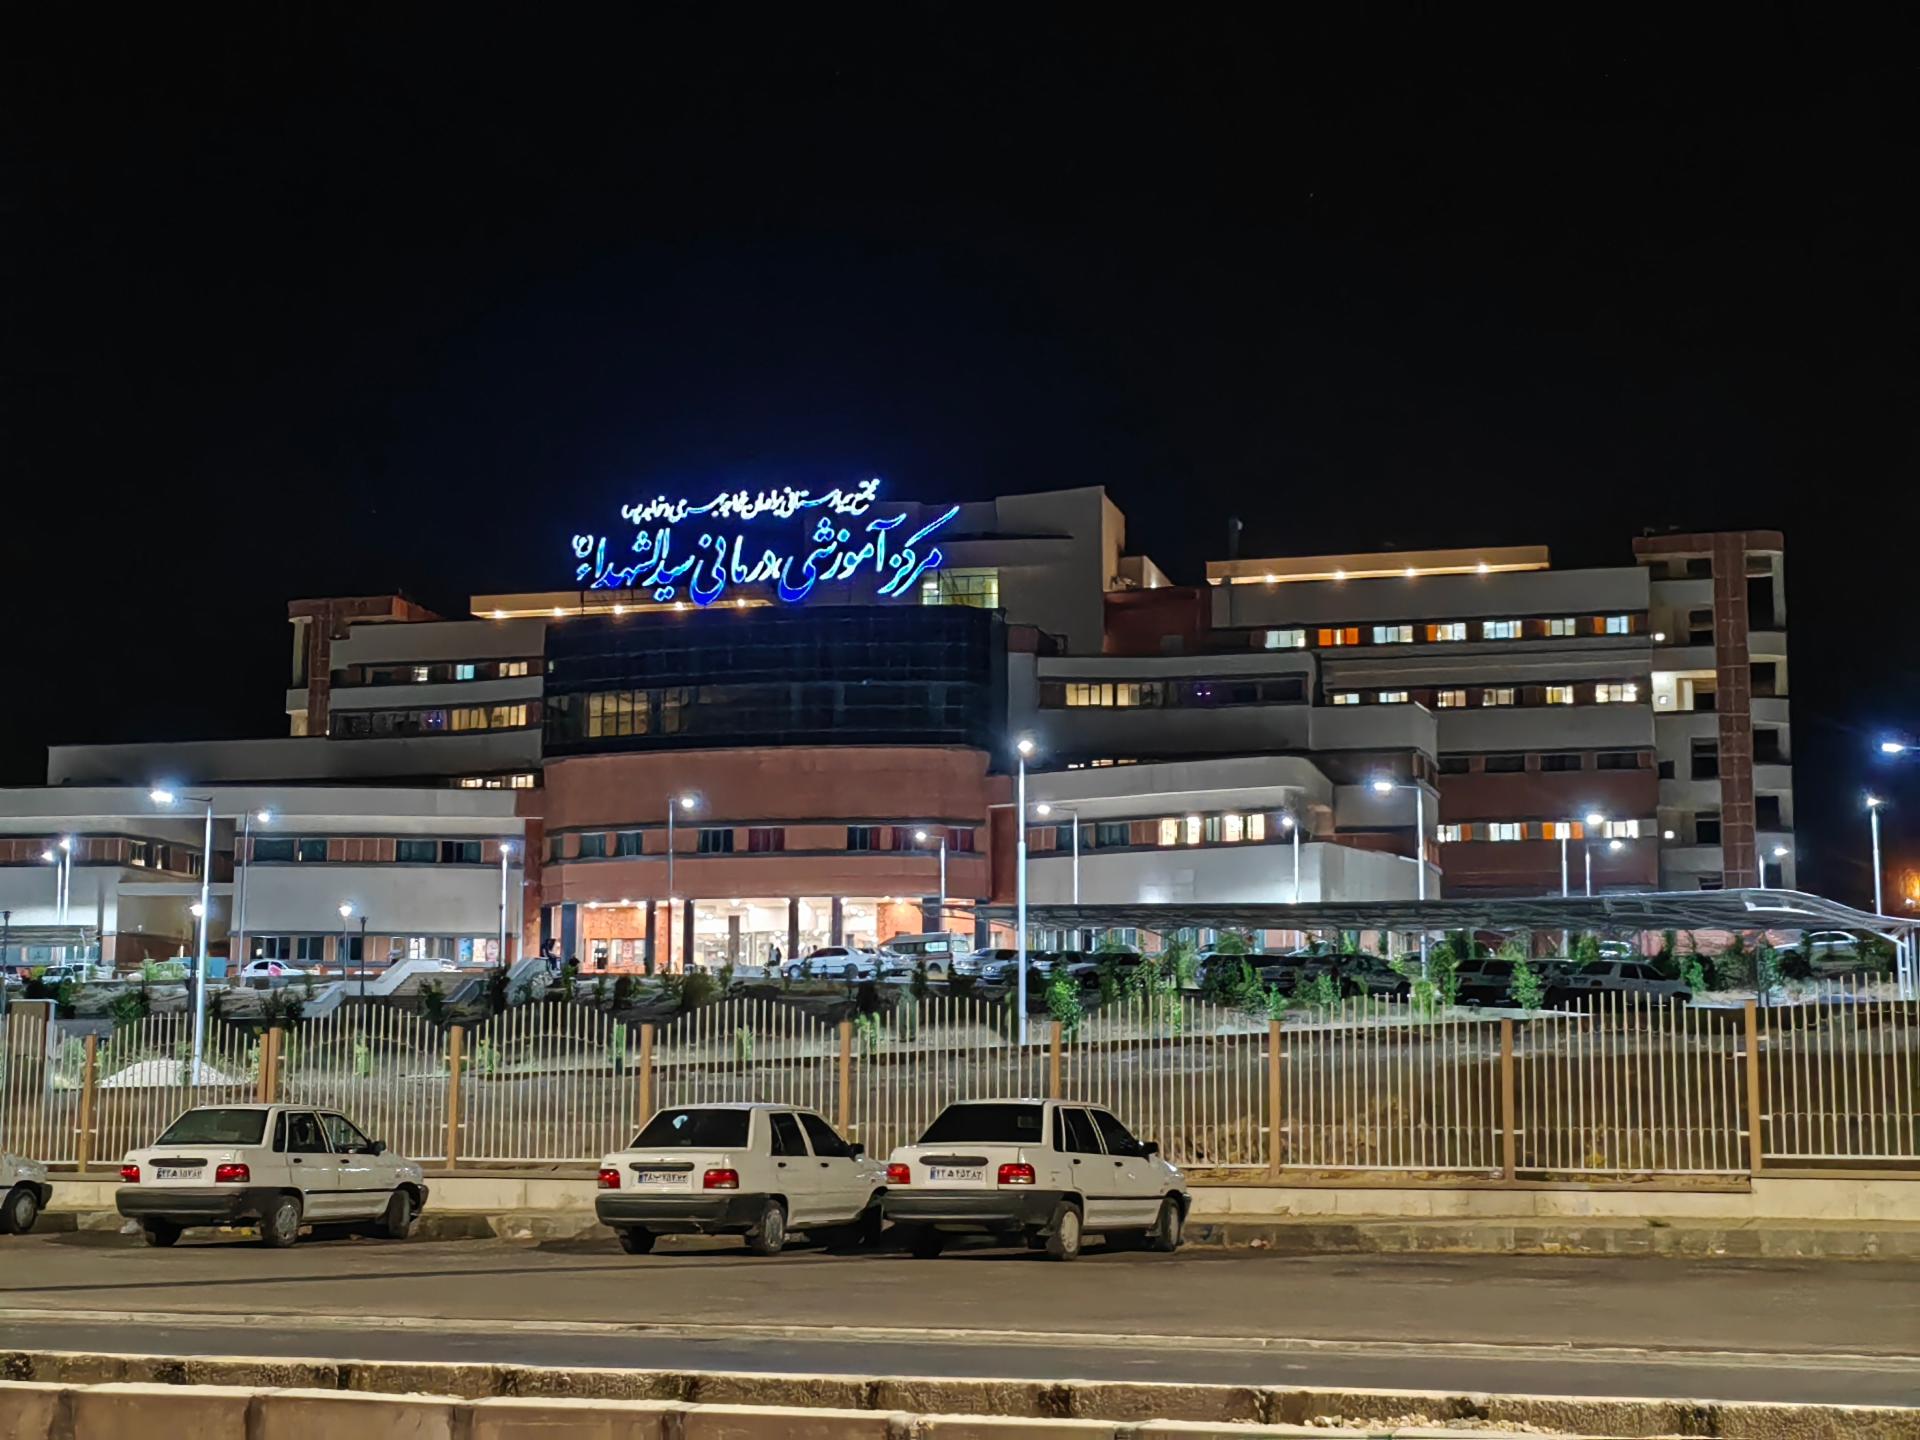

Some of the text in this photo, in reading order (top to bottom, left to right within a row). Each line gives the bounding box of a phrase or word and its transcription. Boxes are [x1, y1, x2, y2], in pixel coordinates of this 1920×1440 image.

[690, 534, 782, 606] درمانی
[778, 513, 907, 602] آموزشی
[878, 506, 959, 597] مرکز
